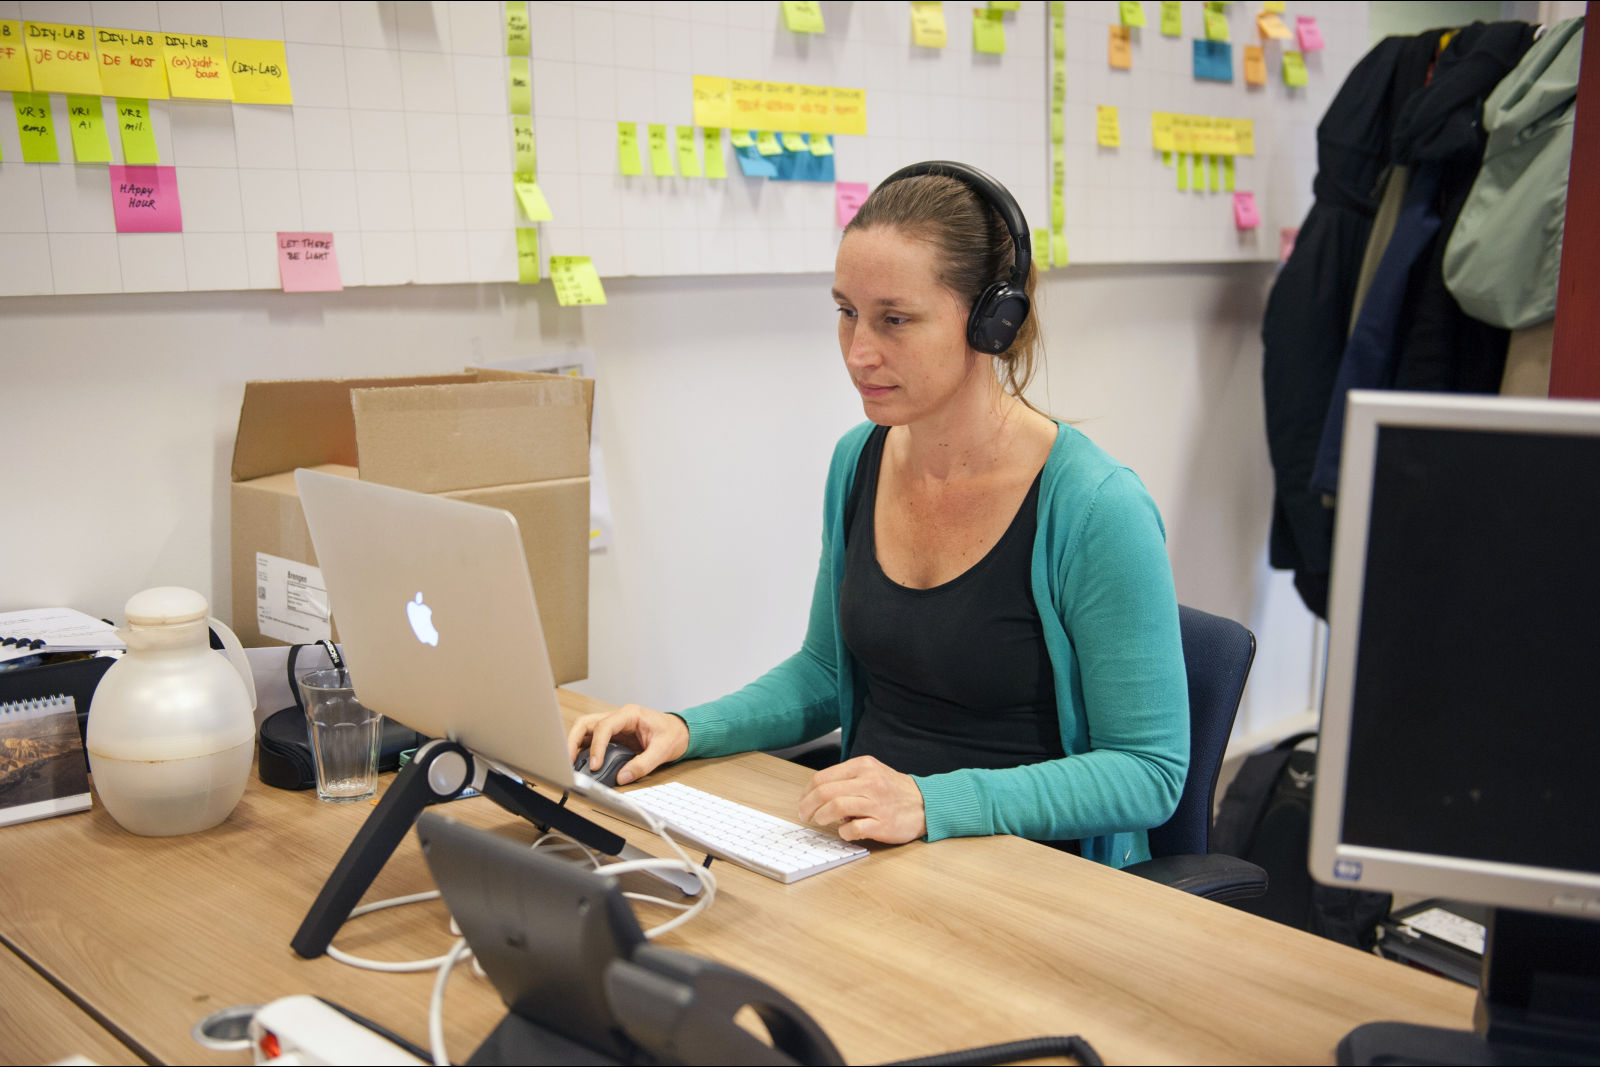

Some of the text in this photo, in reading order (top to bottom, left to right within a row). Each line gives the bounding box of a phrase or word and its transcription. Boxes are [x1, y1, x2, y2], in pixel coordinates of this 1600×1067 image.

[29, 25, 85, 41] DIY-LAB
[98, 31, 154, 46] DIY-LAB
[164, 36, 208, 49] DIY-LAB
[33, 48, 91, 64] JE OGEN
[102, 53, 155, 68] DE KOST
[231, 60, 282, 78] (DIY-LAB)
[280, 239, 330, 250] LET THERE
[287, 252, 300, 260] BE
